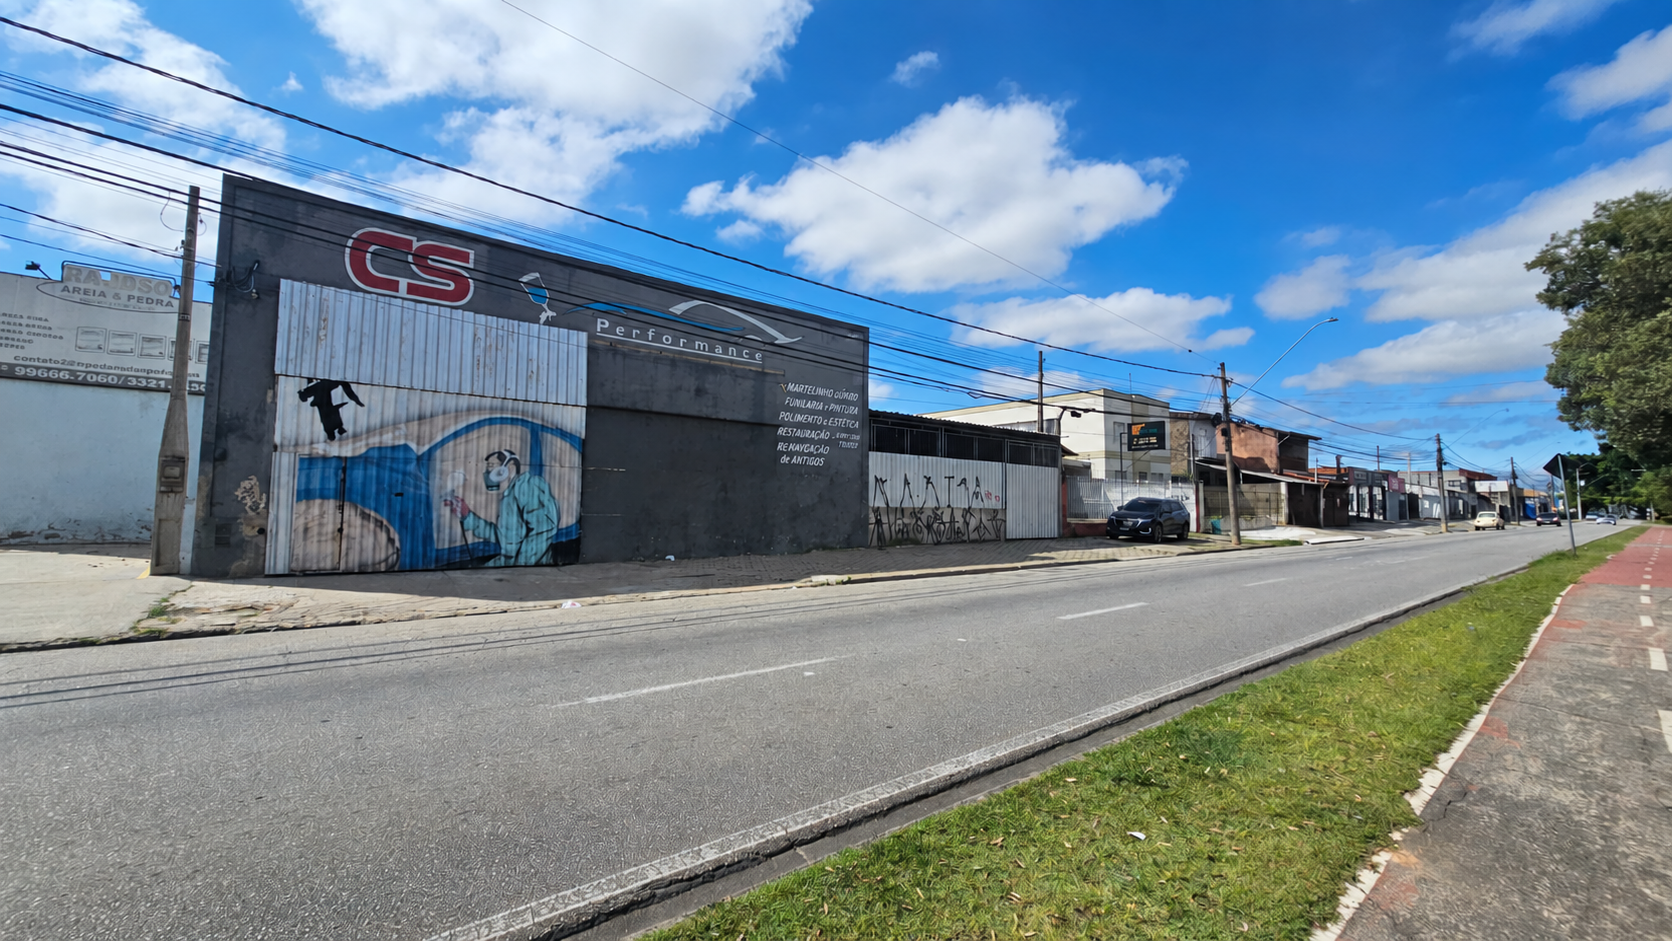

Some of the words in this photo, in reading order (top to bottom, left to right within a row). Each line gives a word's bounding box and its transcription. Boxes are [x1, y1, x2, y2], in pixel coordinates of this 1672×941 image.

[345, 227, 475, 306] CS
[60, 284, 107, 299] AREIA
[112, 292, 122, 301] &
[127, 294, 174, 308] PEDRA
[596, 317, 763, 361] Performance
[786, 382, 834, 398] MARTELINHO
[784, 396, 824, 411] FUNILARIA
[828, 403, 859, 415] PINTURA
[780, 454, 790, 464] de
[790, 455, 826, 467] ANTIGOS
